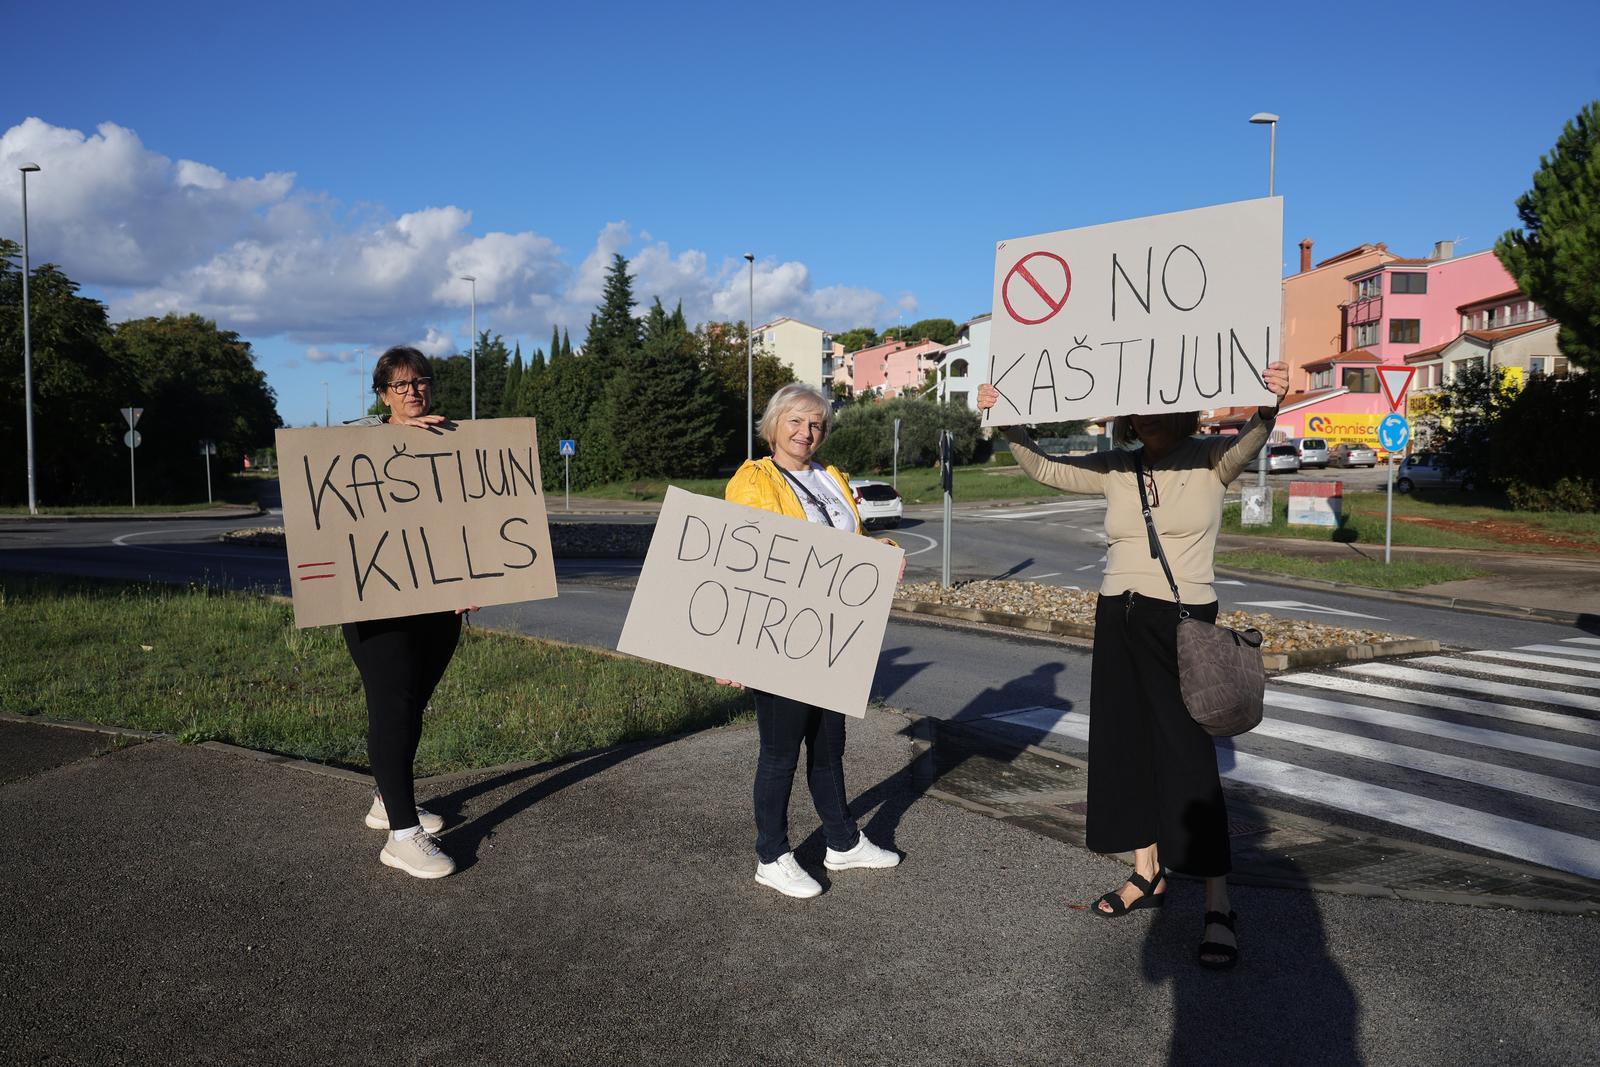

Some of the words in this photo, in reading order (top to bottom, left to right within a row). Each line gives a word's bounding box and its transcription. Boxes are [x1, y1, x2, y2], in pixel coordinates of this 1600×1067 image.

[1112, 244, 1207, 322] NO
[986, 326, 1270, 420] KAŠTIJUN
[303, 442, 537, 530] KAŠTIJUN
[349, 517, 538, 602] KILLS
[677, 514, 880, 607] DIŠEMO
[688, 580, 864, 668] OTROV
